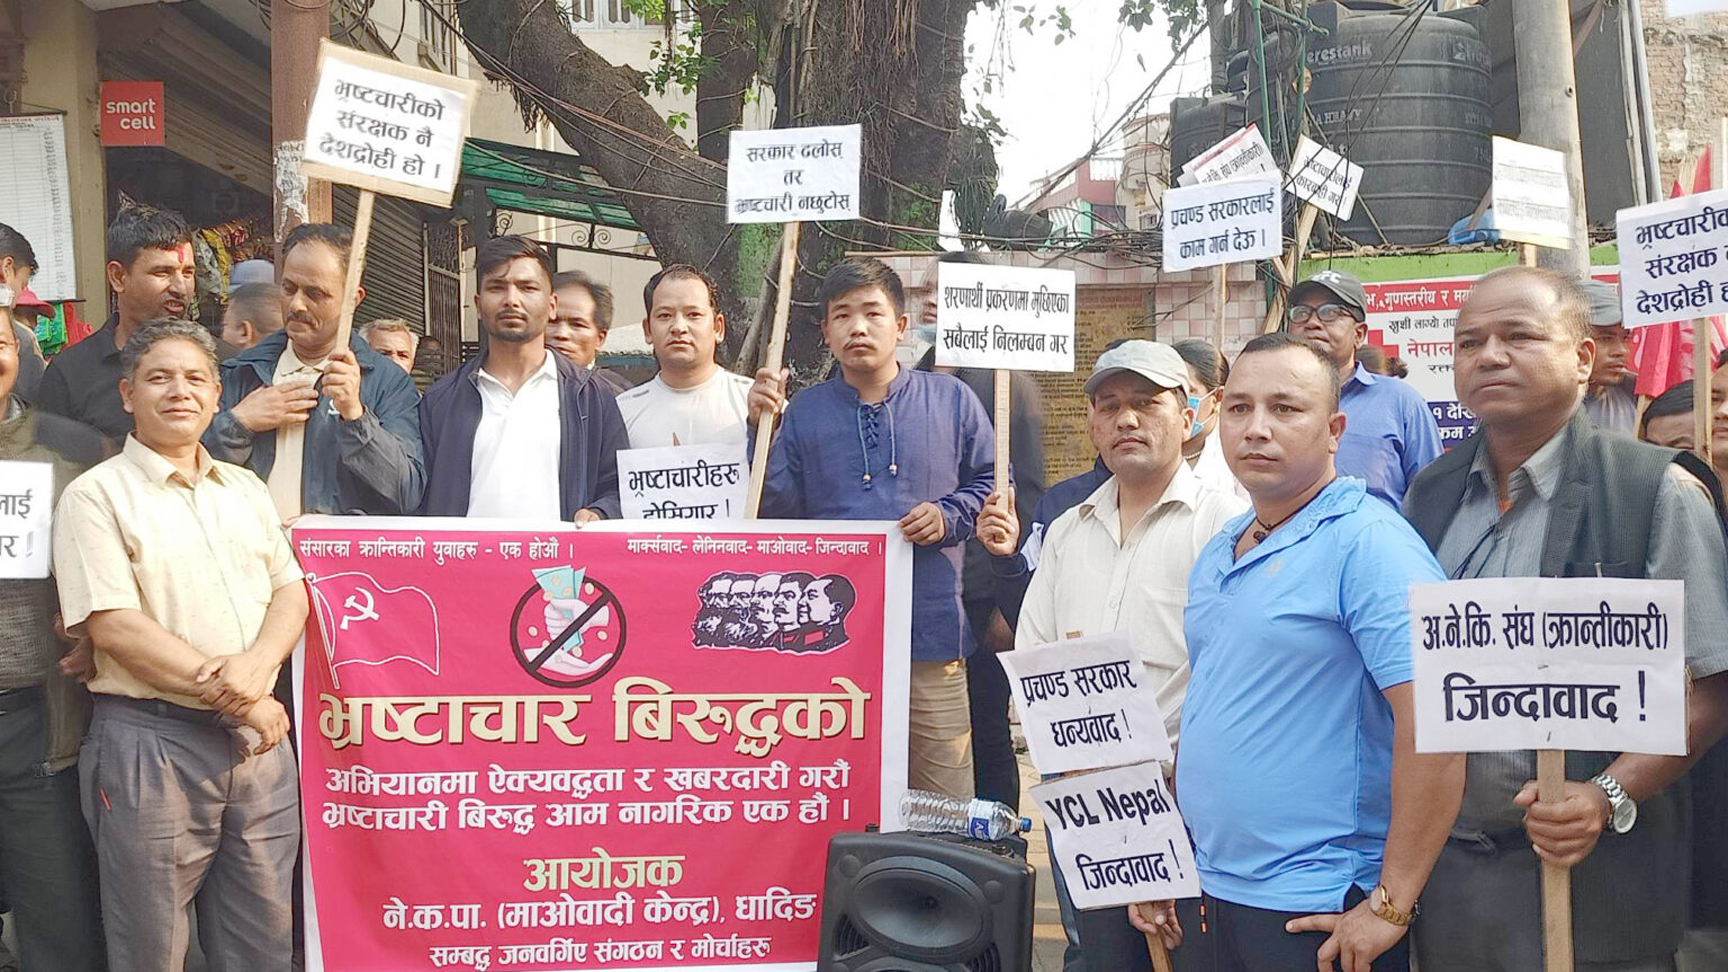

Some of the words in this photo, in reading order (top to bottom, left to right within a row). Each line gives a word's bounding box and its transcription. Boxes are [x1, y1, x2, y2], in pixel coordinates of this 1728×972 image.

[106, 98, 156, 113] smart
[120, 116, 156, 130] cell
[335, 110, 410, 141] संरक्षक
[415, 127, 434, 147] नै
[318, 132, 397, 169] देशद्रोही
[402, 154, 426, 175] हो
[747, 144, 797, 162] सरकार
[783, 170, 805, 185] तर
[1171, 205, 1205, 230] प्रचण्ड
[1208, 187, 1275, 221] सरकारलाई
[1180, 239, 1205, 259] काम
[1209, 229, 1229, 254] गर्न
[1645, 247, 1718, 279] संरक्षक
[986, 289, 1029, 312] प्रकरणमा
[1385, 286, 1436, 310] गुणस्तरीय
[1440, 289, 1450, 306] र
[1636, 280, 1713, 314] देशद्रोही
[1050, 334, 1069, 355] गर
[1407, 338, 1454, 358] नेपाल
[300, 537, 352, 559] संसारका
[359, 536, 425, 560] क्रान्तिकारी
[500, 541, 522, 560] एक
[815, 538, 869, 556] जिन्दावाद
[1421, 600, 1496, 650] अ.ने.कि.
[1502, 604, 1535, 649] संघ
[1542, 600, 1668, 650] (क्रान्तीकारी)
[1020, 671, 1069, 707] प्रचण्ड
[1071, 660, 1137, 697] सरकार
[1443, 672, 1621, 724] जिन्दावाद
[318, 692, 592, 750] भ्रष्टाचार
[1050, 713, 1121, 748] धन्यवाद
[325, 764, 478, 796] अभियानमा
[634, 768, 656, 791] र
[664, 760, 791, 791] खबरदारी
[322, 800, 449, 832] भ्रष्टाचारी
[545, 802, 609, 827] आम
[618, 794, 734, 824] नागरिक
[742, 800, 791, 824] एक
[1045, 793, 1100, 830] YCL
[1097, 779, 1171, 825] Nepal
[523, 846, 686, 891] आयोजक
[1075, 852, 1171, 890] जिन्दावाद
[382, 897, 487, 930] ने.क.पा.
[497, 891, 635, 929] (माओवादी
[736, 886, 817, 922] धादिङ
[594, 938, 664, 963] संगठन
[670, 940, 686, 960] र
